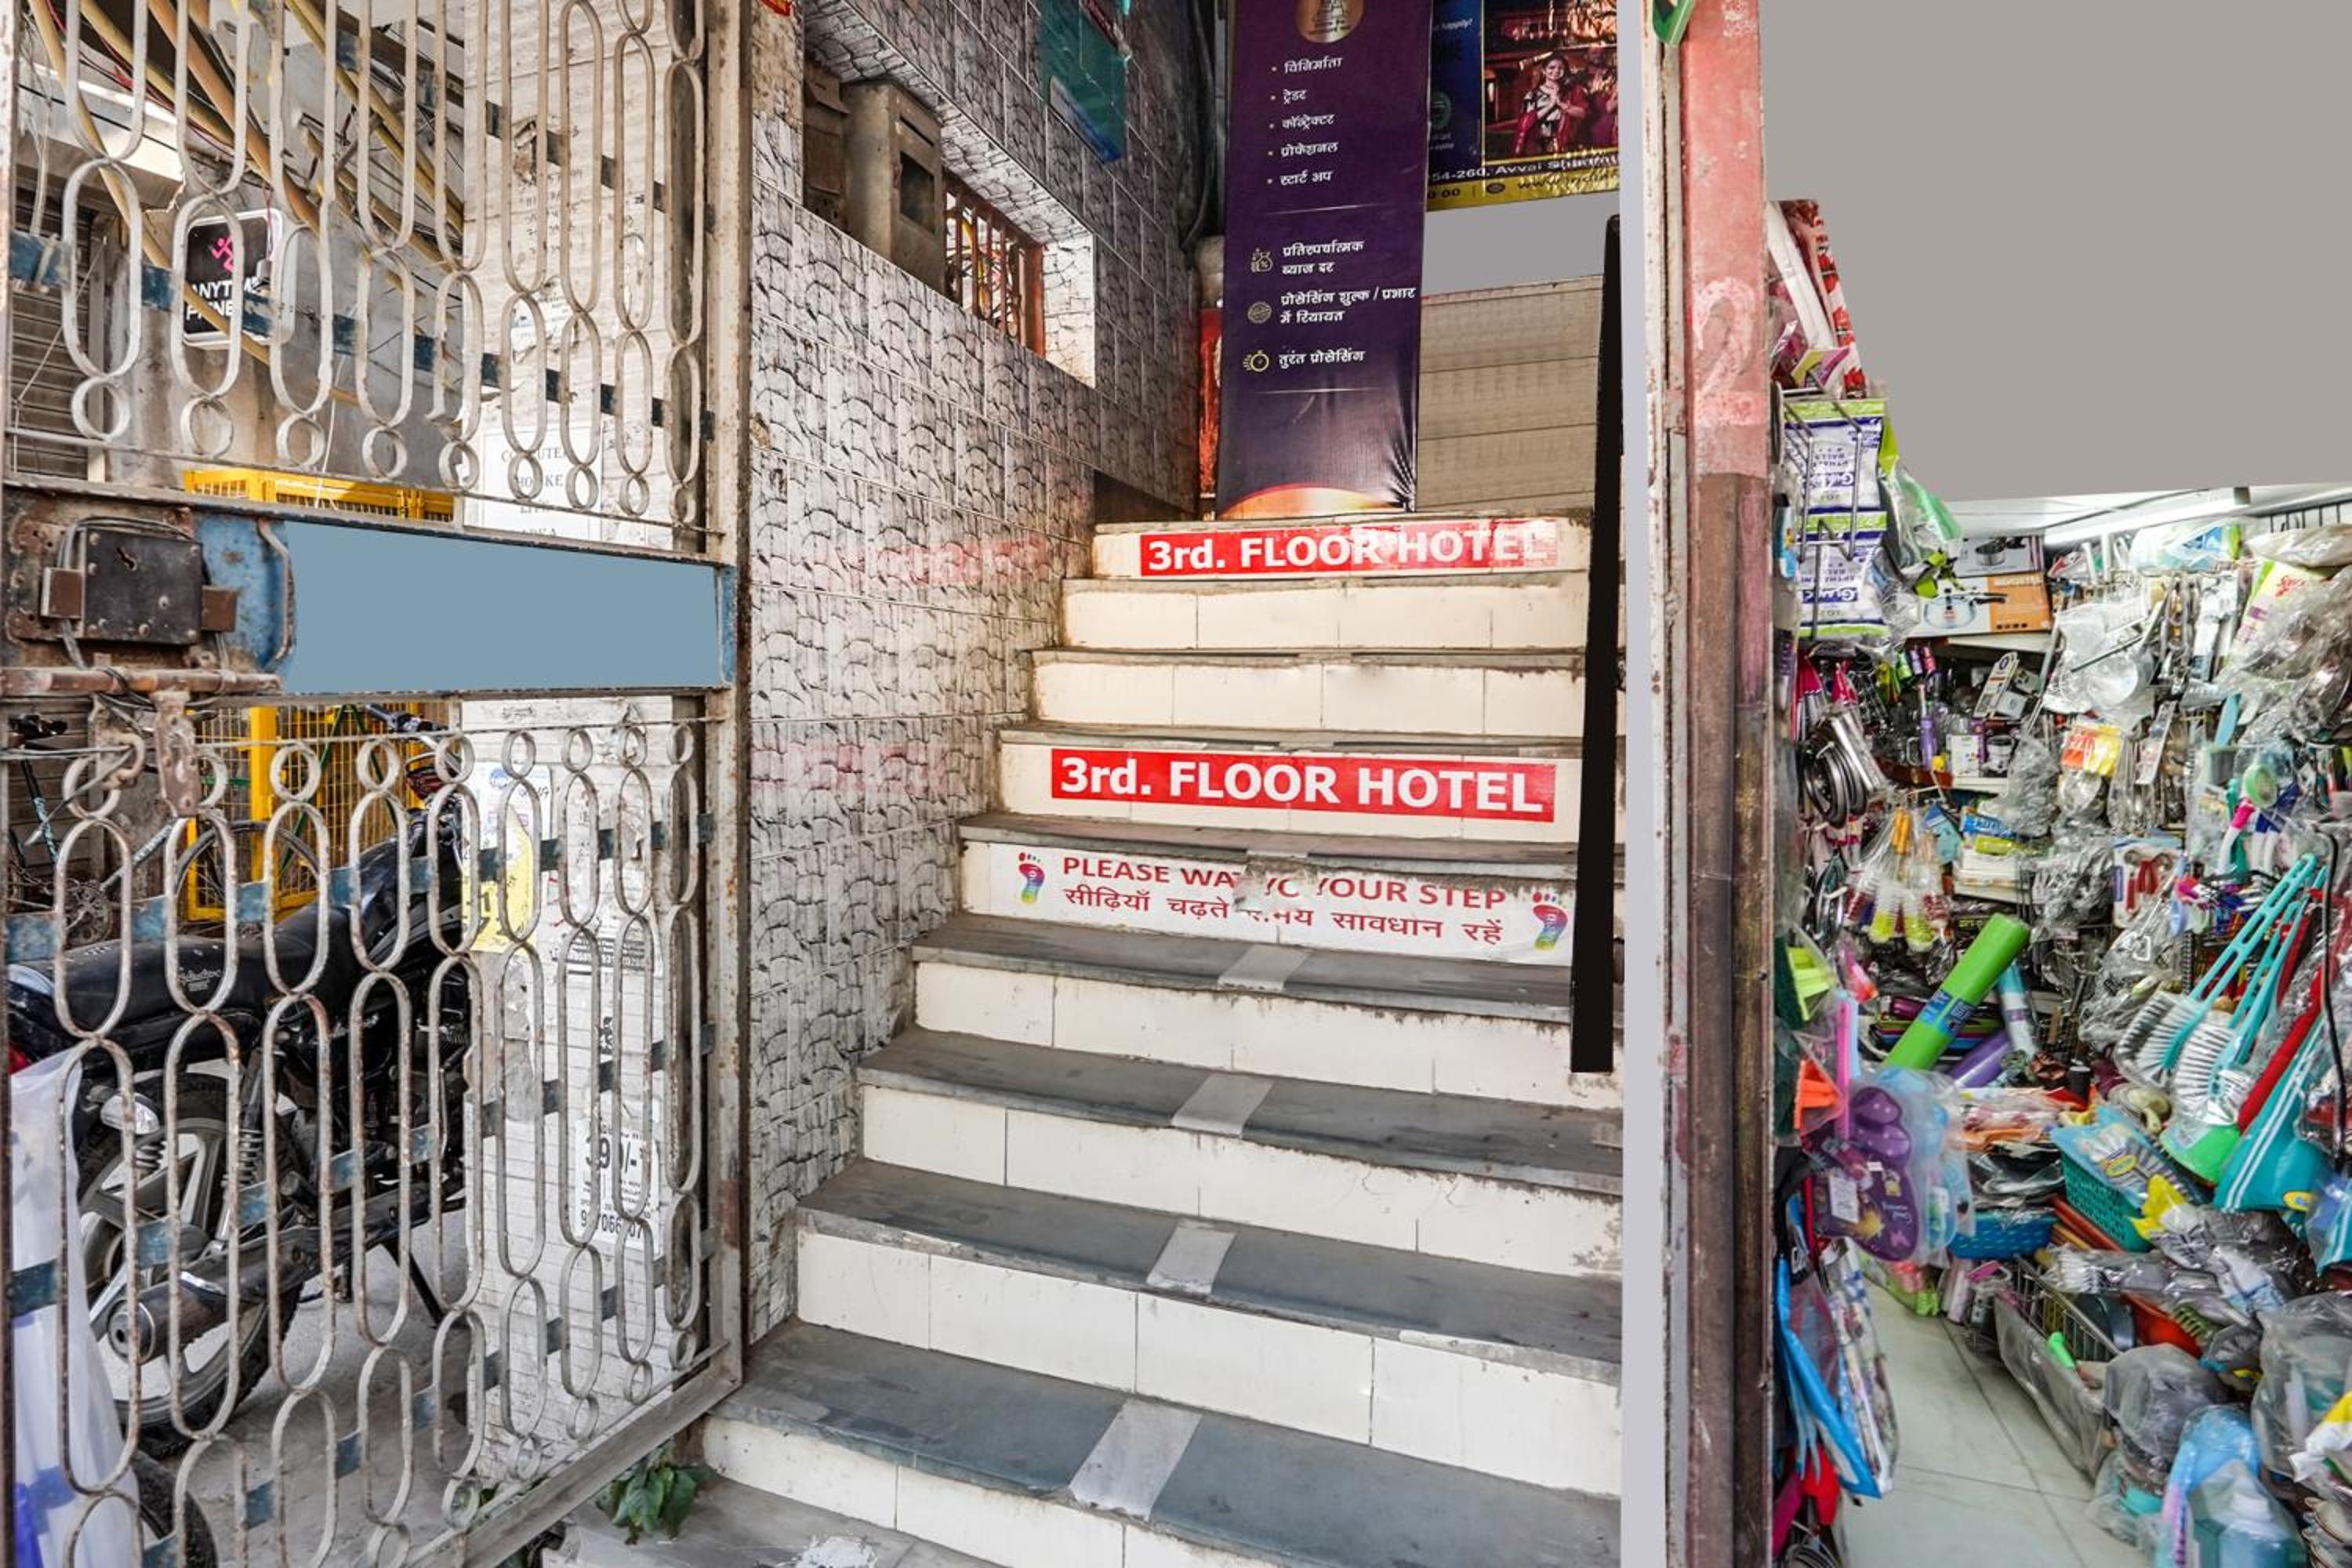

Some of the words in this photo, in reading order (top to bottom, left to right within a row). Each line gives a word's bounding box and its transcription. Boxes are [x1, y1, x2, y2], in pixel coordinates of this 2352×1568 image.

[1312, 170, 1333, 183] अप
[1319, 261, 1336, 274] दर
[1147, 539, 1226, 572] 3rd.
[1240, 531, 1384, 568] FLOOR
[1396, 526, 1550, 564] HOTEL
[1060, 757, 1152, 796] 3rd.
[1169, 760, 1341, 805] FLOOR
[1358, 768, 1544, 814] HOTEL
[1063, 857, 1171, 884] PLEASE
[1063, 884, 1152, 913] सीढ़ियाँ
[1166, 896, 1230, 920] चढ़ते
[1330, 910, 1443, 938] सावधान
[1461, 918, 1504, 946] रहें
